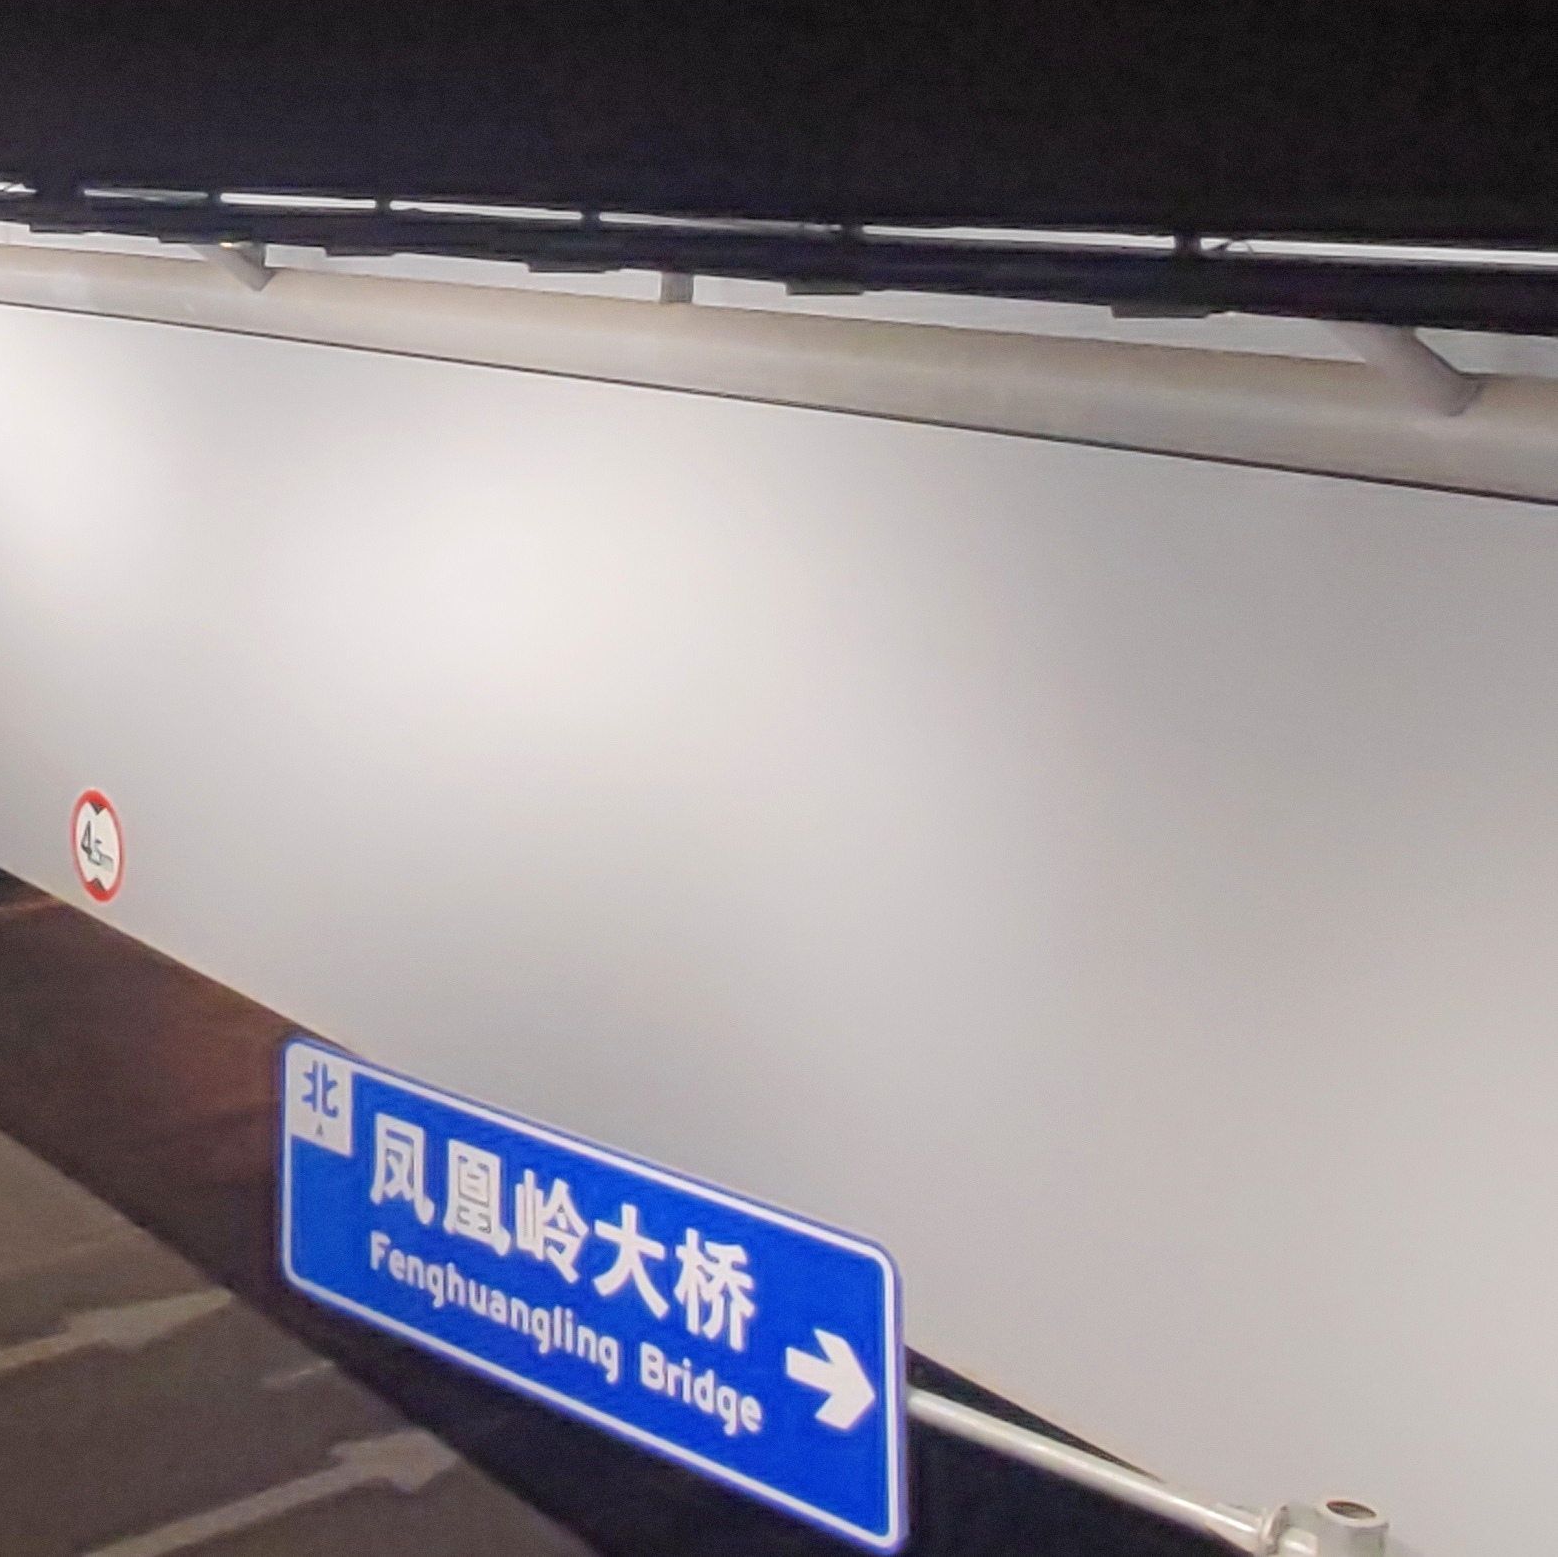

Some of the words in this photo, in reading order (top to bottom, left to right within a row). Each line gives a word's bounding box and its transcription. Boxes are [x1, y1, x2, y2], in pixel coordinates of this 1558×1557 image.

[302, 1060, 340, 1119] 北
[369, 1112, 755, 1351] 凤凰岭大桥
[370, 1231, 620, 1383] Fenghuangling
[640, 1342, 763, 1436] Bridge
